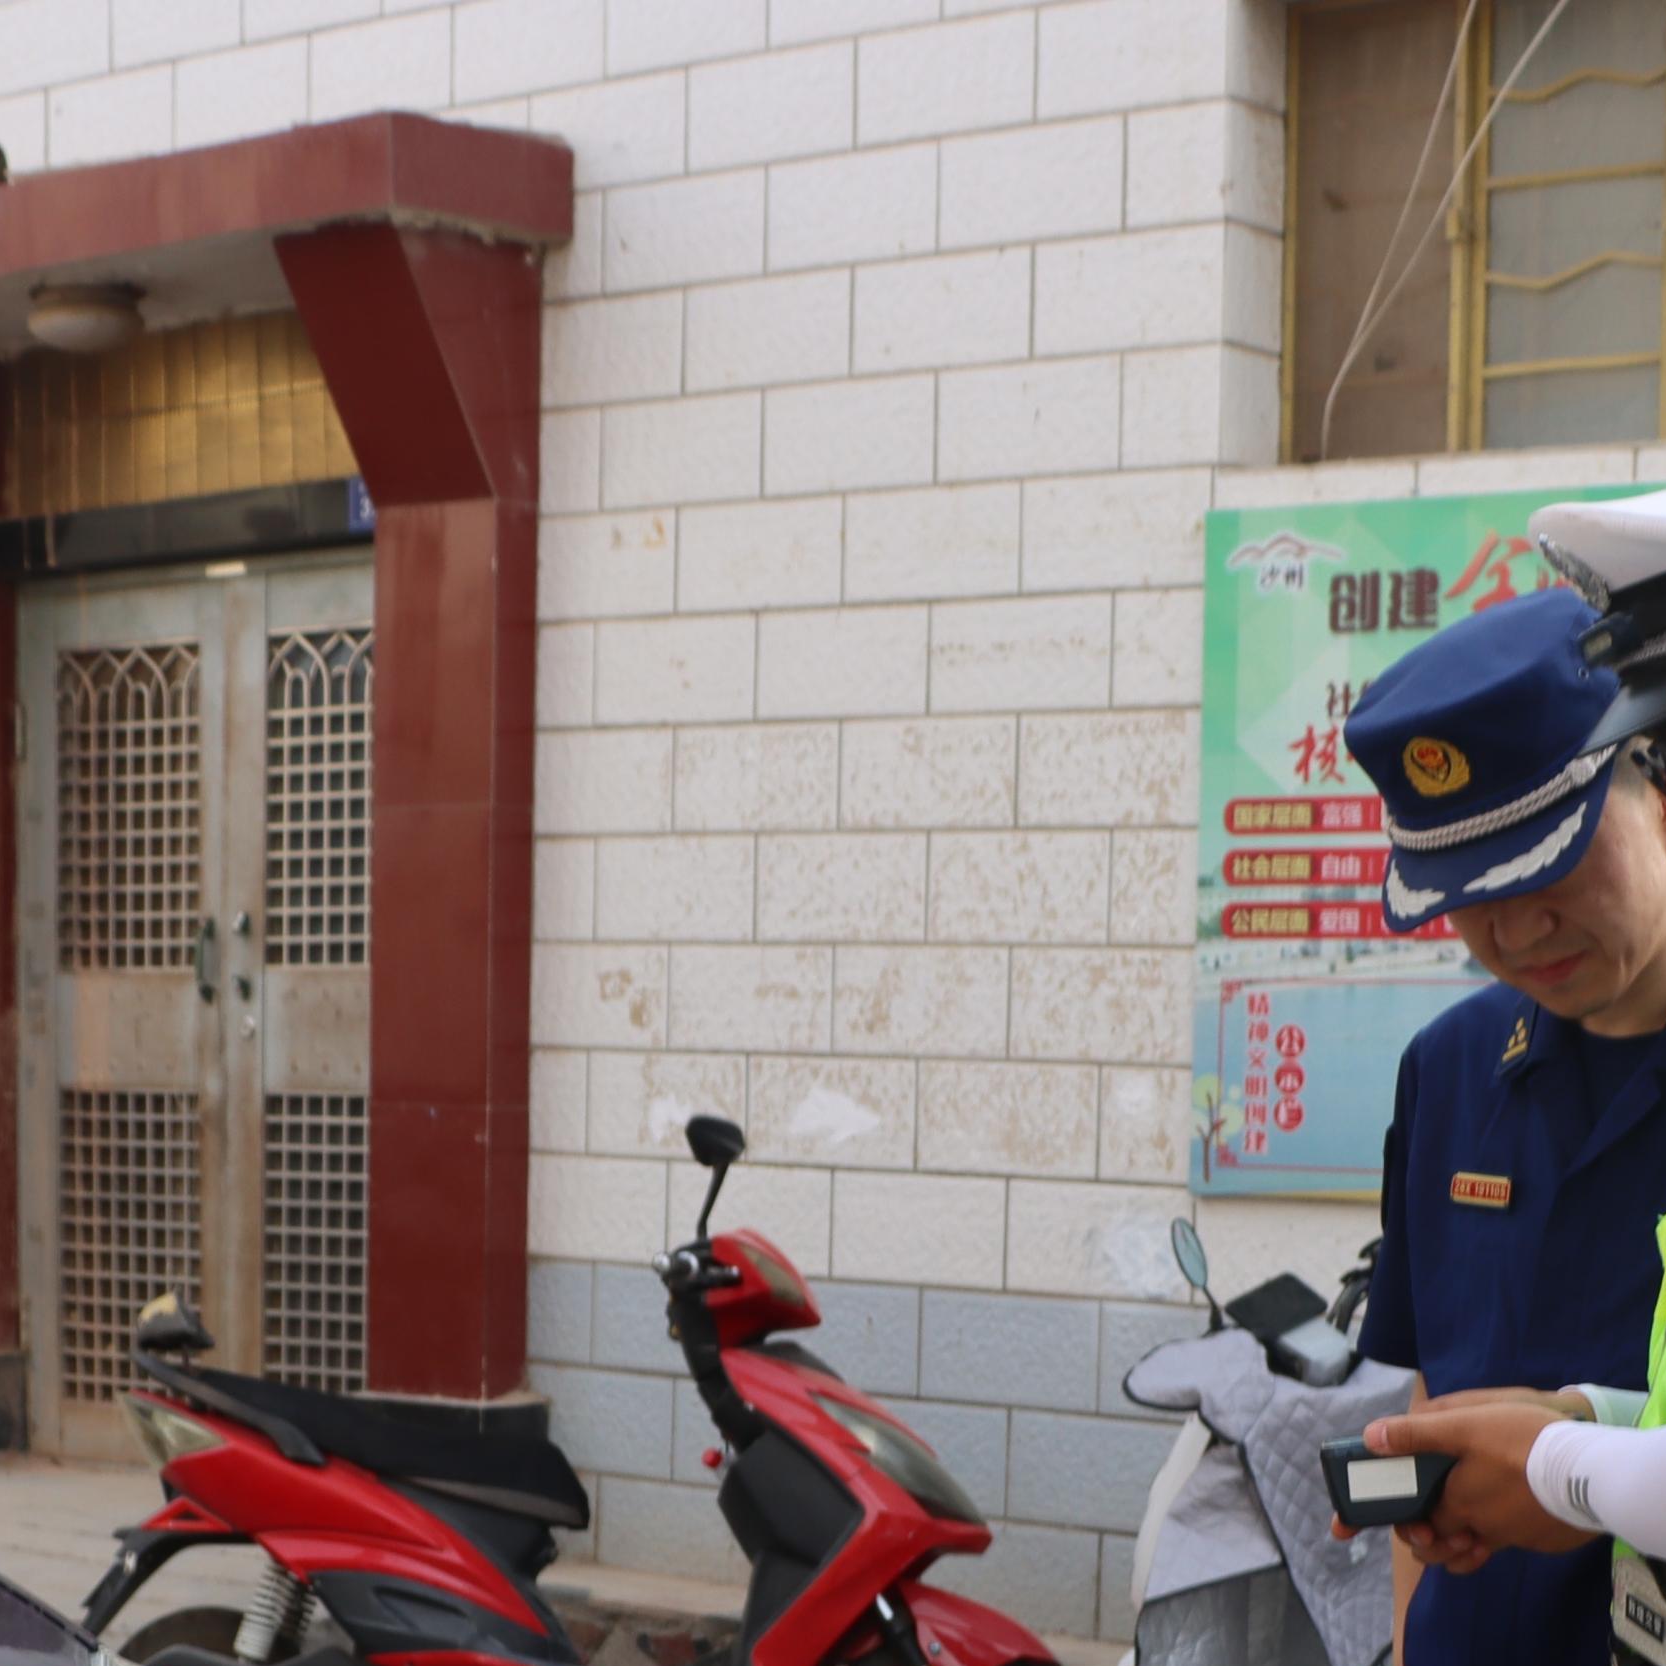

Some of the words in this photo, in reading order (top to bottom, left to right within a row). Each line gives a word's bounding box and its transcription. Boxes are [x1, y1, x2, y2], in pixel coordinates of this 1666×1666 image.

[1289, 725, 1355, 785] 核
[1234, 802, 1312, 829] 国家层面
[1322, 802, 1363, 827] 富强
[1233, 854, 1311, 880] 社会层面
[1320, 854, 1361, 878] 自由
[1231, 908, 1310, 934] 公民层面
[1319, 908, 1360, 933] 爱国
